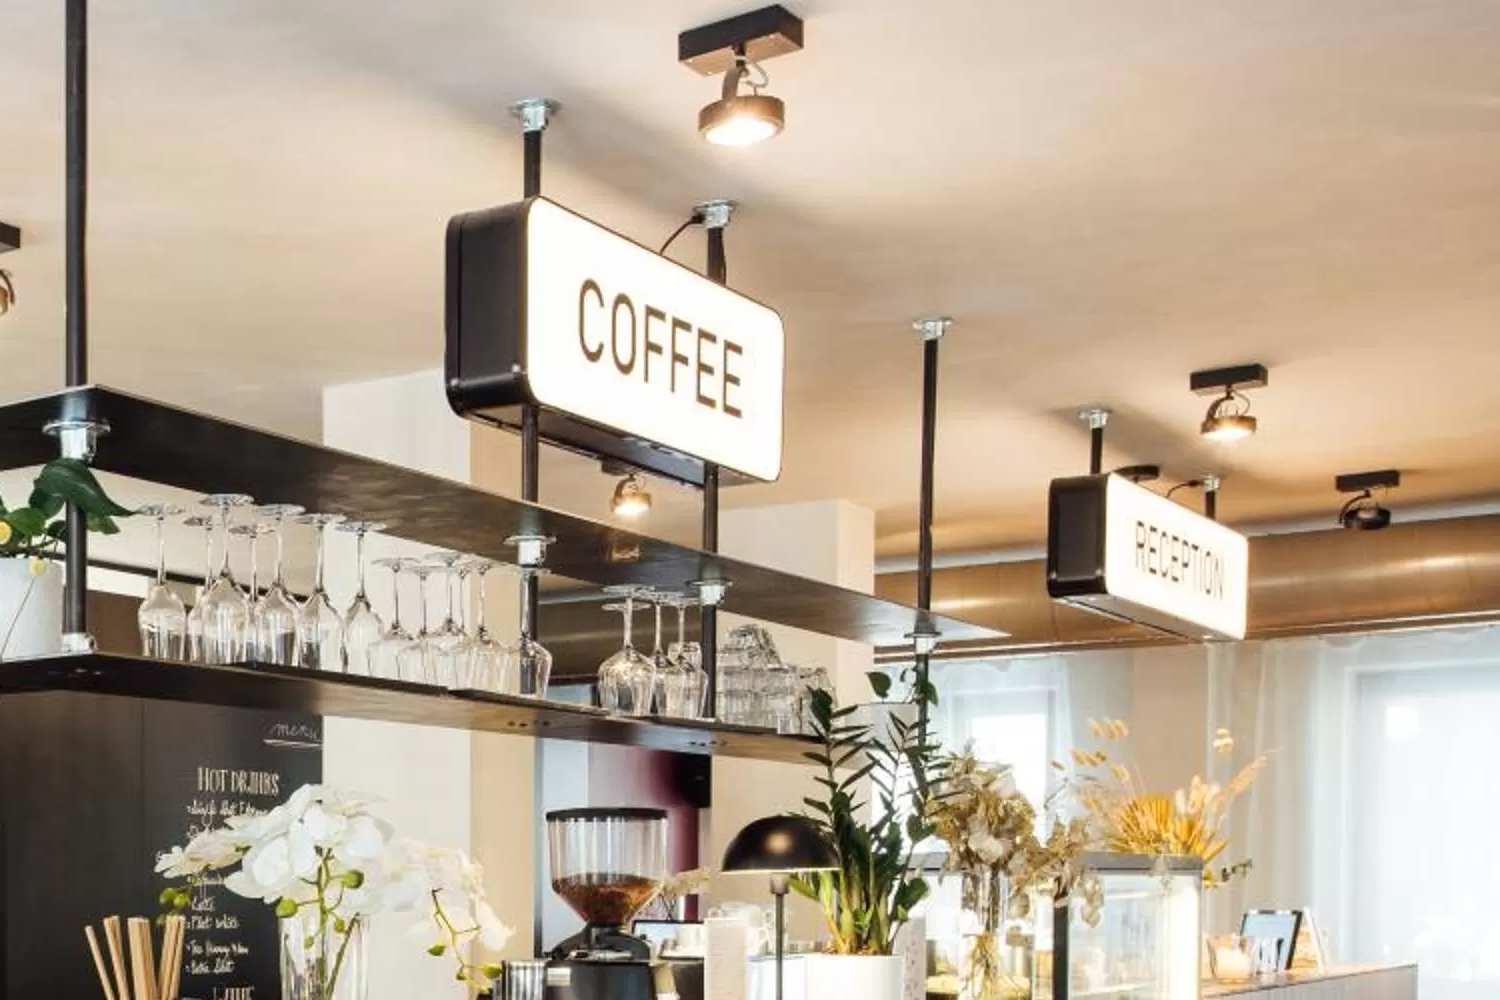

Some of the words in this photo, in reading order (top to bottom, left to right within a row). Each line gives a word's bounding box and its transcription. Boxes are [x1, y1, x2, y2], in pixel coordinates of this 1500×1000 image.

[578, 277, 744, 420] COFFEE
[1135, 520, 1225, 602] RECEPTION
[268, 722, 319, 739] menu
[197, 767, 228, 793] HOT
